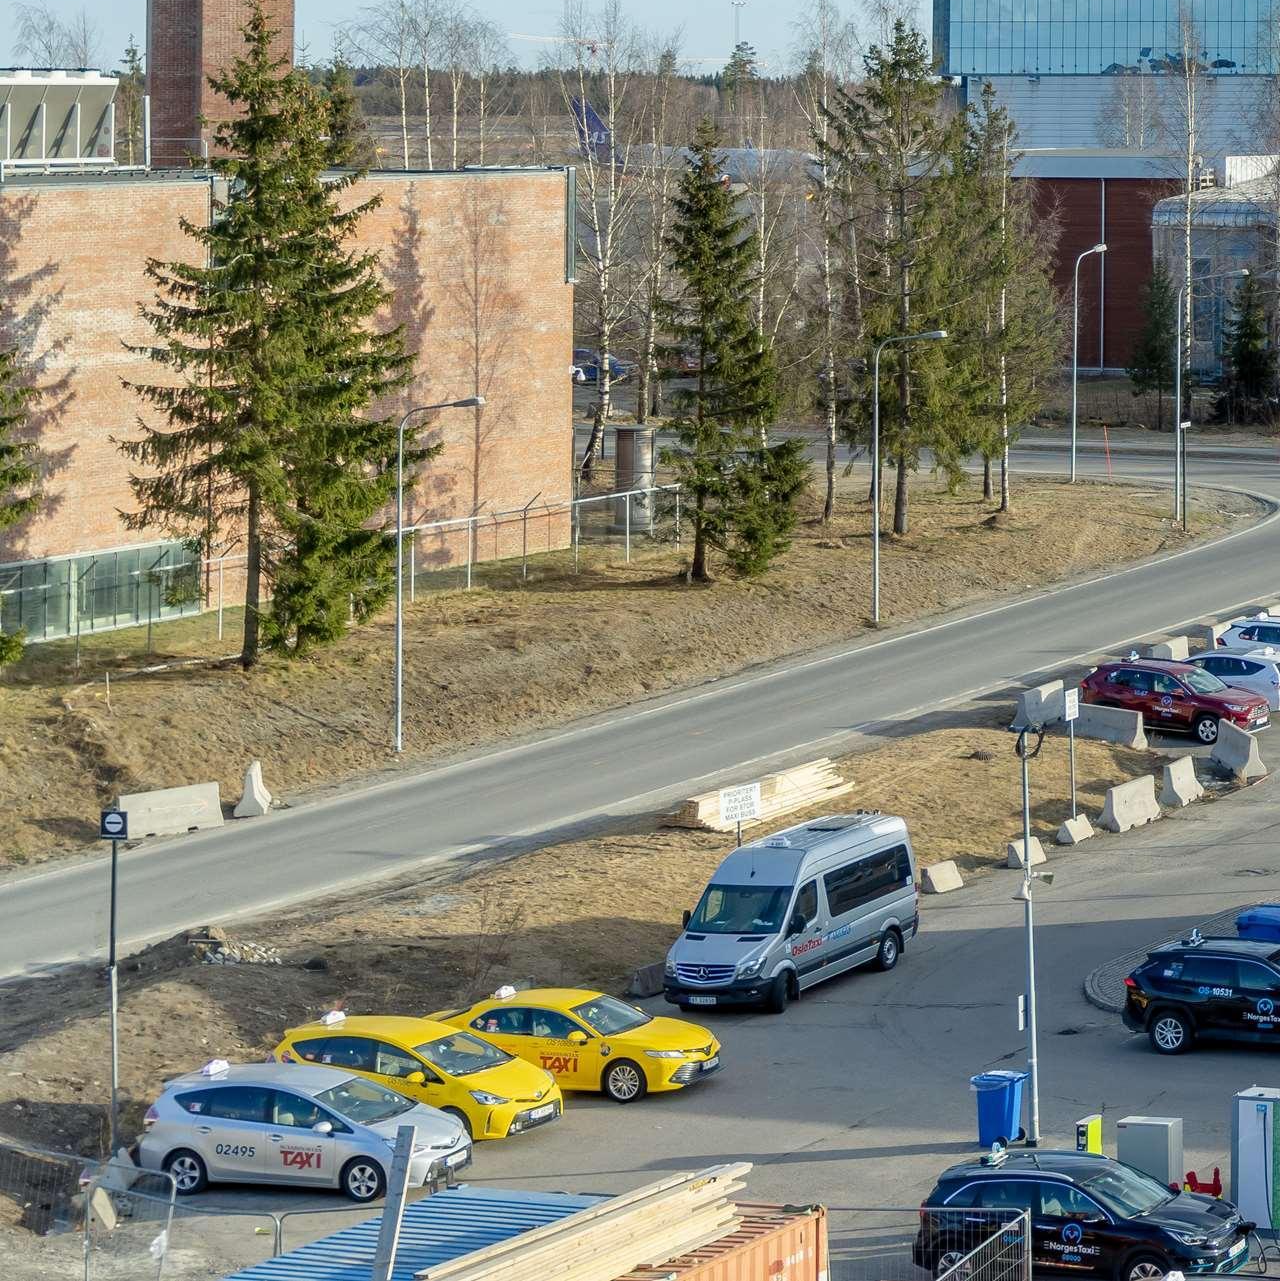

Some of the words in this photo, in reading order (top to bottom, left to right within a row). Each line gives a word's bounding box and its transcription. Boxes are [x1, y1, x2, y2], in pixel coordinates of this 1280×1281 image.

[791, 935, 823, 957] OsloTaxi
[539, 1055, 578, 1074] TAXI
[215, 1143, 255, 1157] 02495
[279, 1150, 322, 1170] TAXI
[1049, 1241, 1096, 1255] NorgesTaxi
